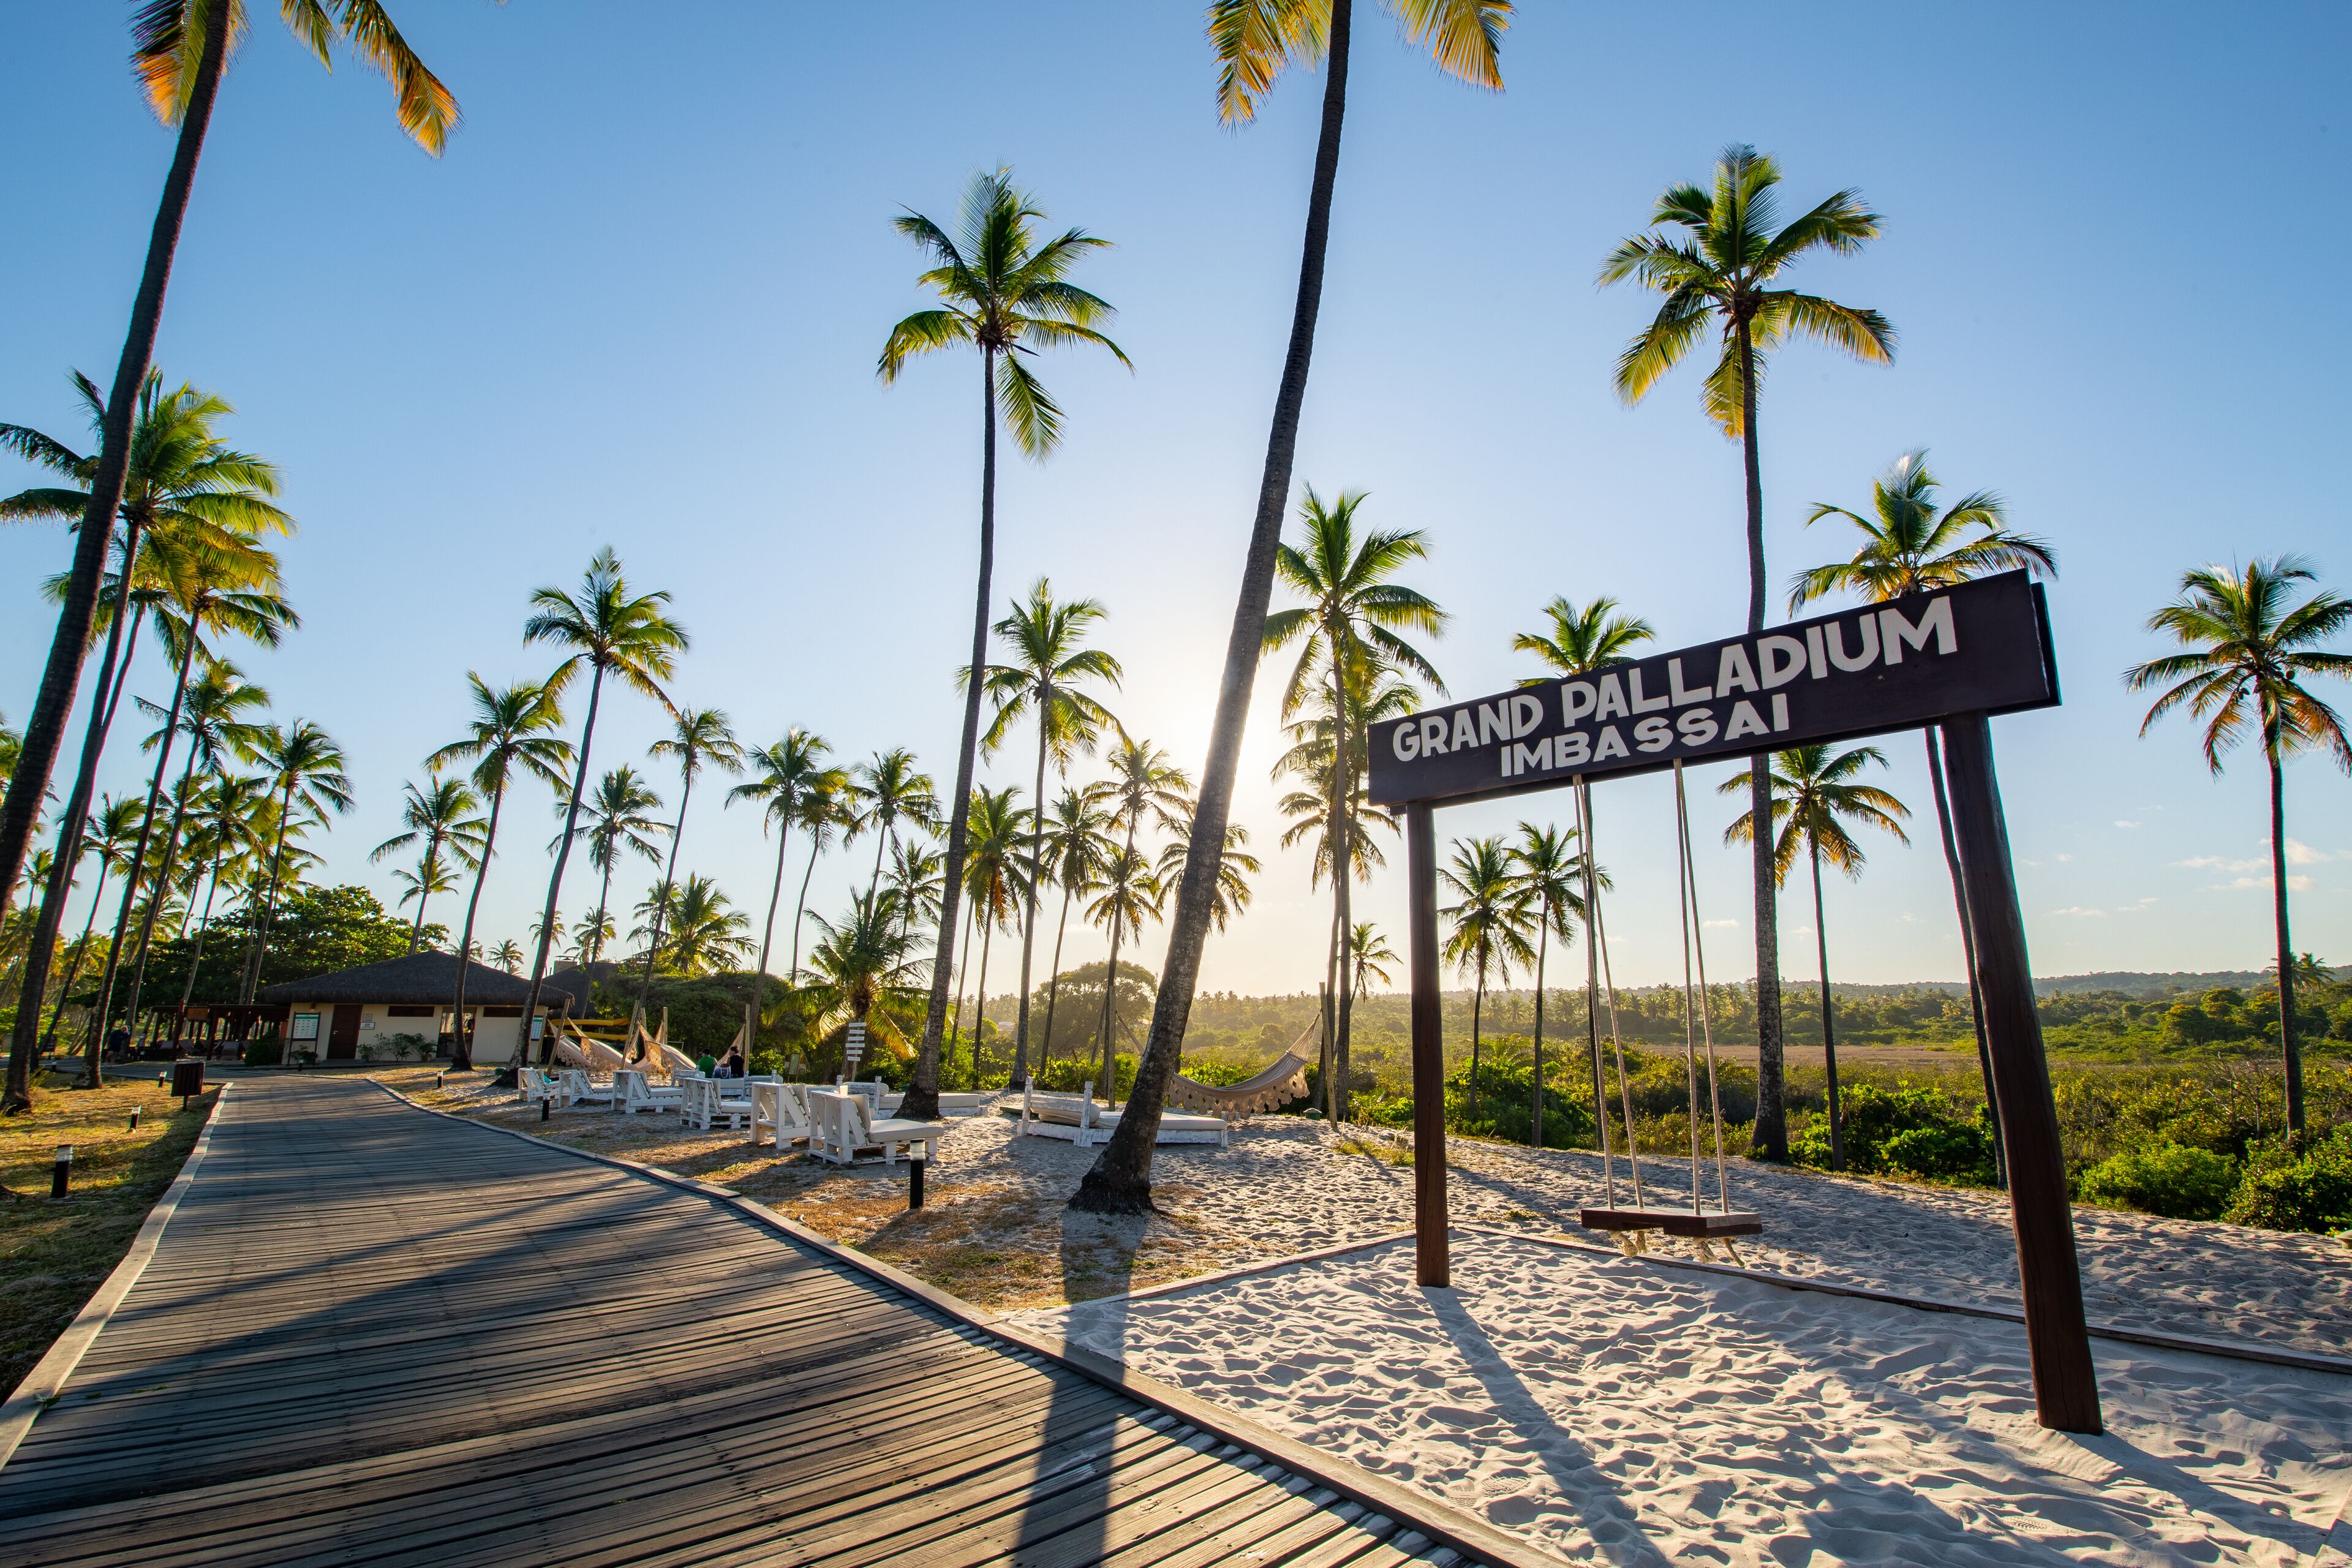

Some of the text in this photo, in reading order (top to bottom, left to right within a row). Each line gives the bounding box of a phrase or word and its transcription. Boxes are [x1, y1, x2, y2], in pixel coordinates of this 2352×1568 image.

[1393, 596, 1958, 762] GRAND PALLADIUM
[1501, 693, 1789, 777] IMBASSAI
